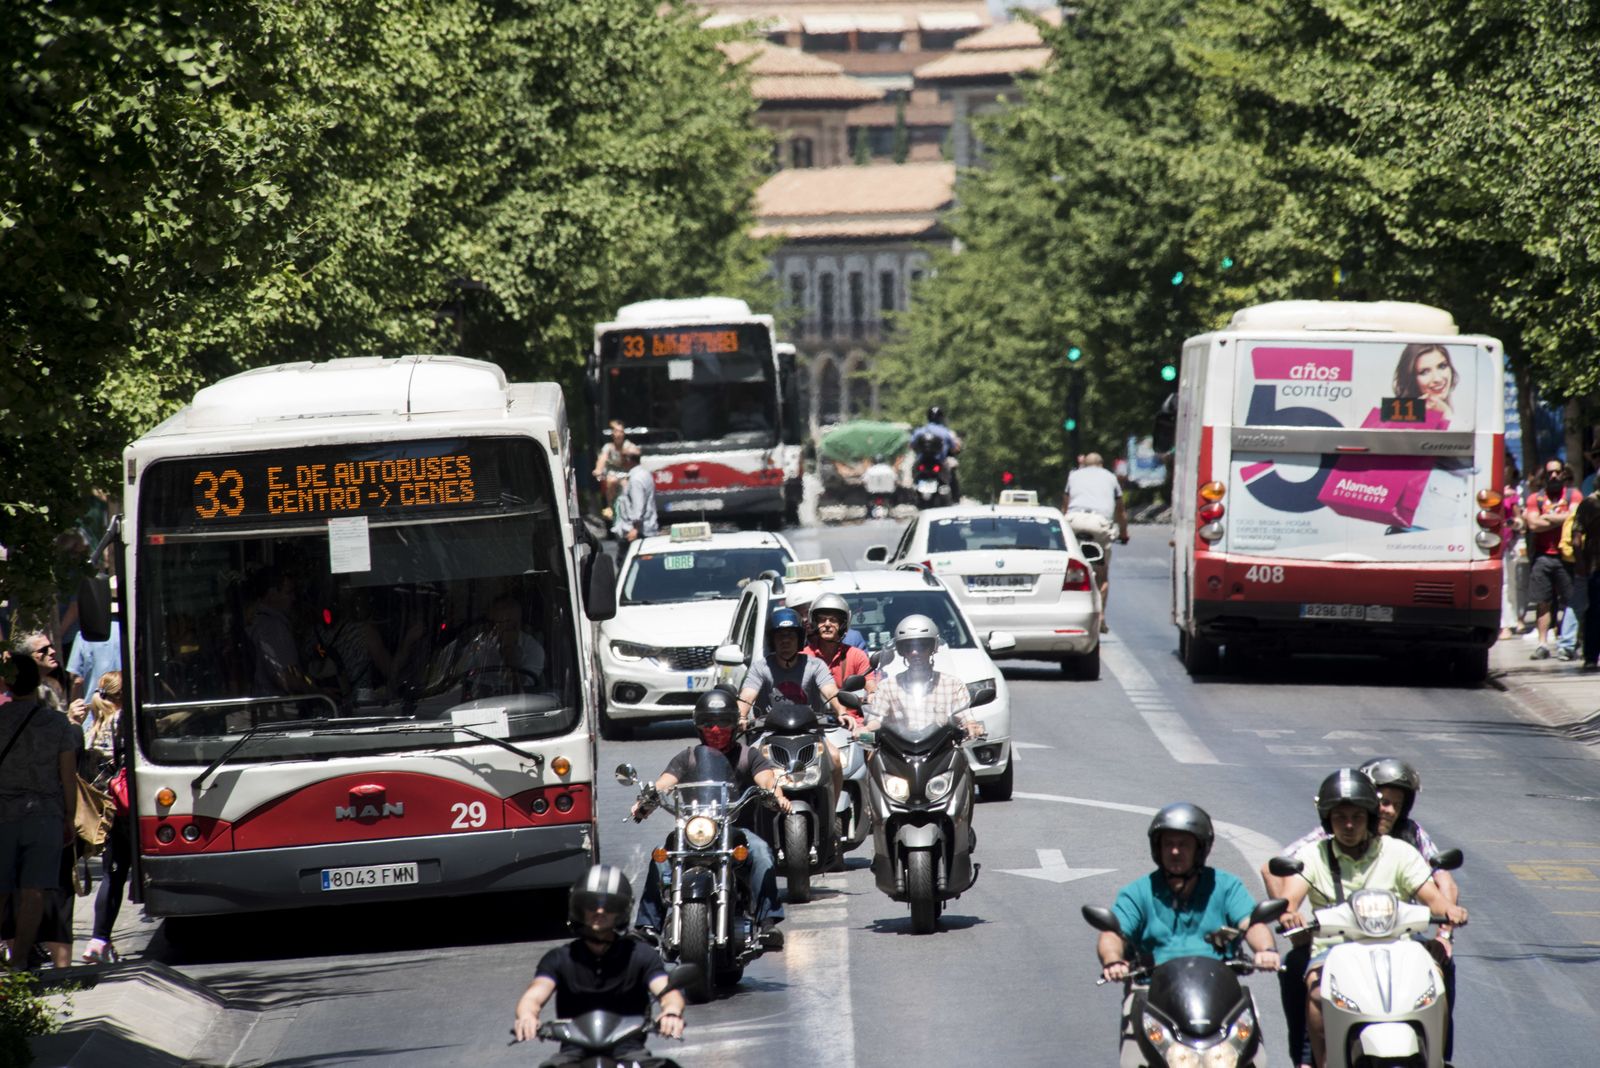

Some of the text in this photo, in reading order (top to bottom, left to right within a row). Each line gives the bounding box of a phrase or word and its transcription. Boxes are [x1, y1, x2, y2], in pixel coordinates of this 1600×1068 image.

[623, 335, 645, 358] 33
[1289, 362, 1341, 380] años
[1281, 381, 1353, 402] contigo
[1391, 400, 1416, 421] 11
[267, 455, 472, 490] E. DE AUTOBUSES
[194, 469, 245, 518] 33
[268, 486, 361, 514] CENTRO
[400, 479, 476, 506] CENES
[1336, 478, 1389, 497] Alameda
[667, 556, 692, 569] LIBRE
[1245, 565, 1285, 584] 408
[335, 803, 404, 821] MAN
[450, 801, 487, 829] 29
[333, 866, 415, 887] 8043 FMN
